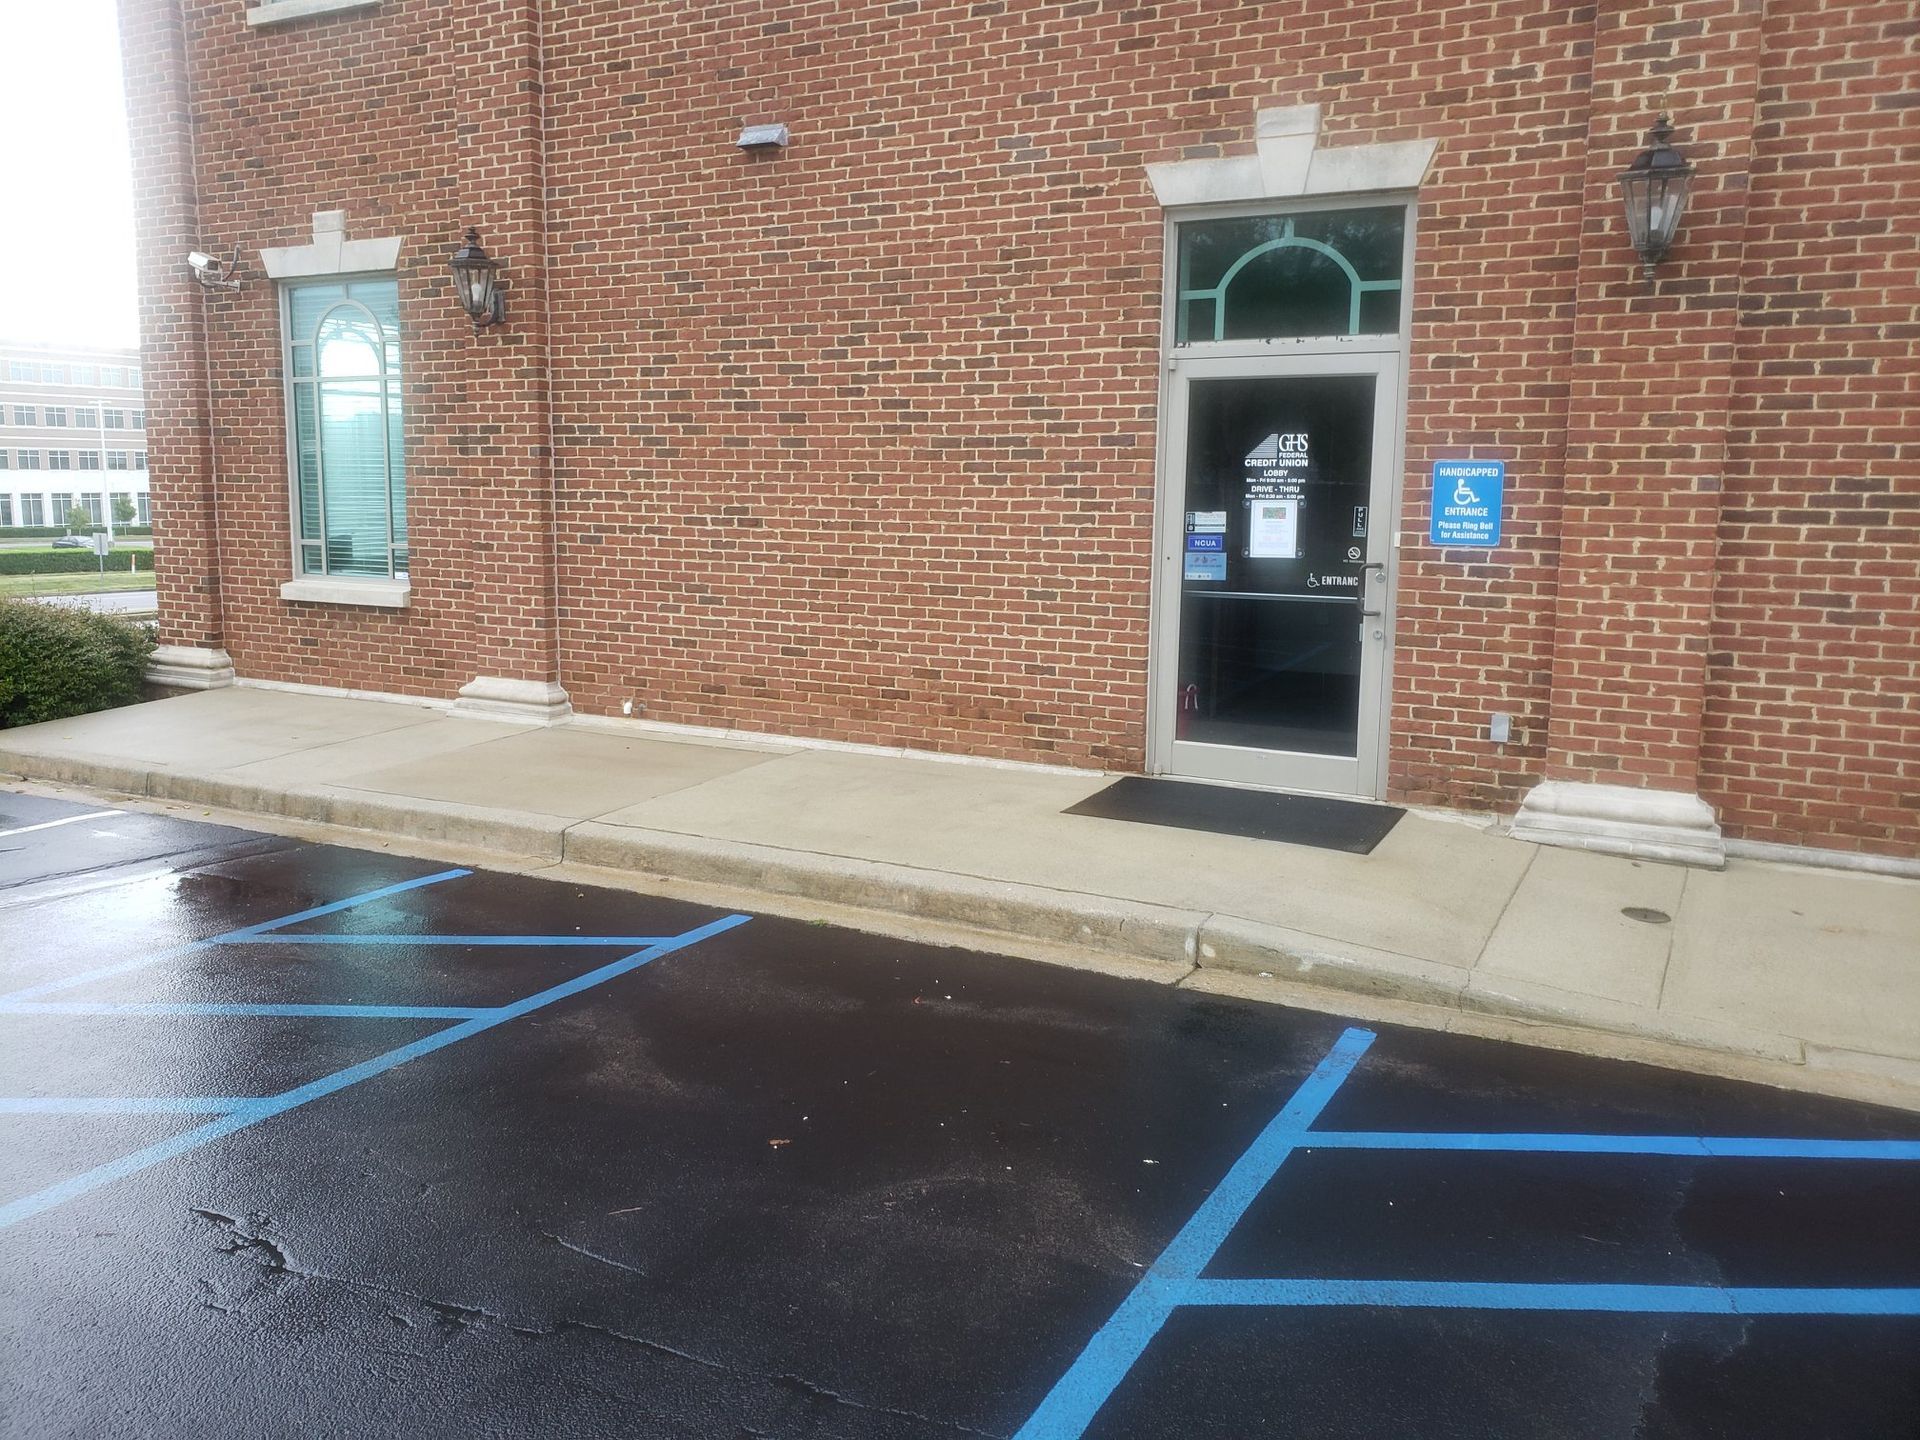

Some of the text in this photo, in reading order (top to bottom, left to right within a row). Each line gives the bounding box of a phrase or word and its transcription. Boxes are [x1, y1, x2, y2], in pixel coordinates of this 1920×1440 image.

[1279, 434, 1308, 452] GHS
[1245, 459, 1308, 467] CREDIT UNION
[1440, 467, 1498, 477] HANDICAPPED
[1444, 507, 1488, 516] ENTRANCE
[1438, 521, 1494, 531] Please Ring Bell
[1441, 531, 1489, 540] for Assistance
[1321, 576, 1359, 586] ENTRANC
